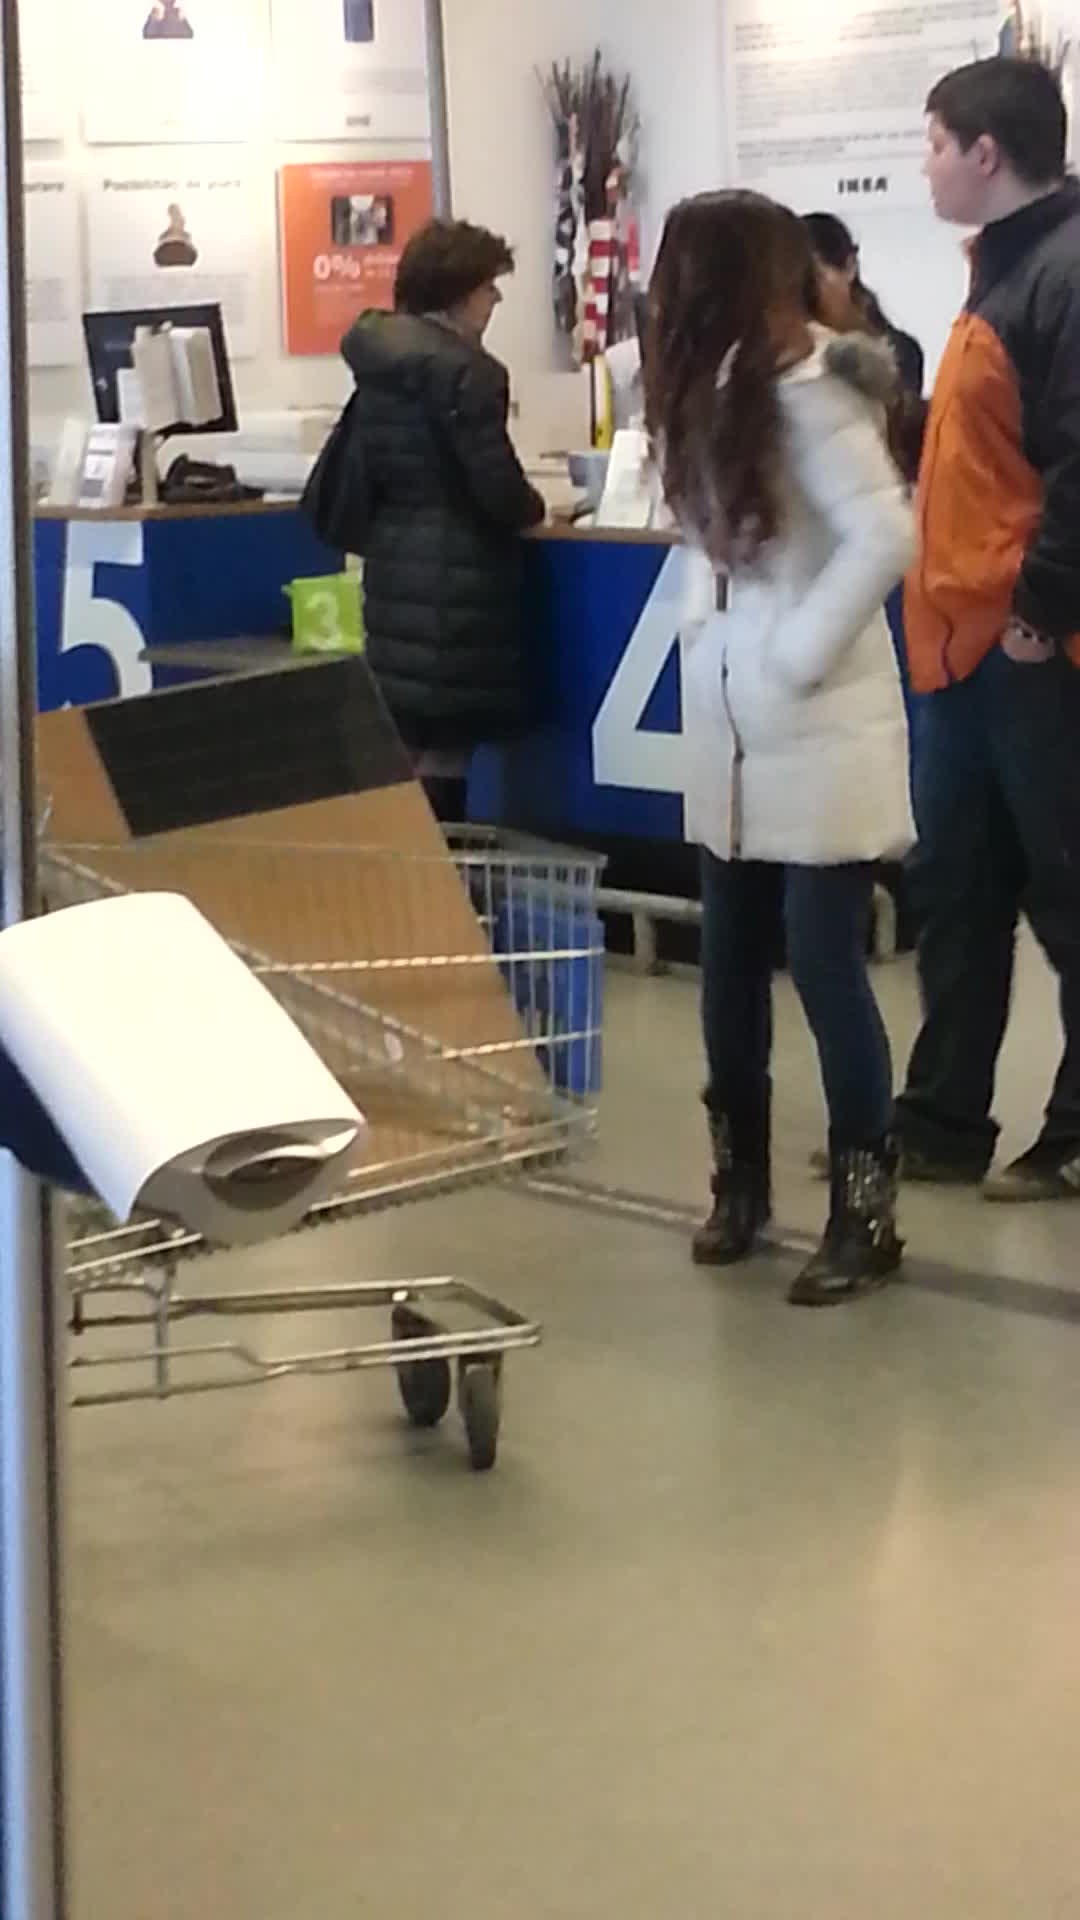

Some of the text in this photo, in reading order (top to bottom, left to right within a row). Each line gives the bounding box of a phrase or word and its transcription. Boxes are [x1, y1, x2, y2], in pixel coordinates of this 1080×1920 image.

[837, 176, 888, 194] IKEA
[313, 253, 361, 280] 0%
[61, 520, 152, 709] 5
[304, 591, 343, 651] 3
[591, 545, 685, 794] 4
